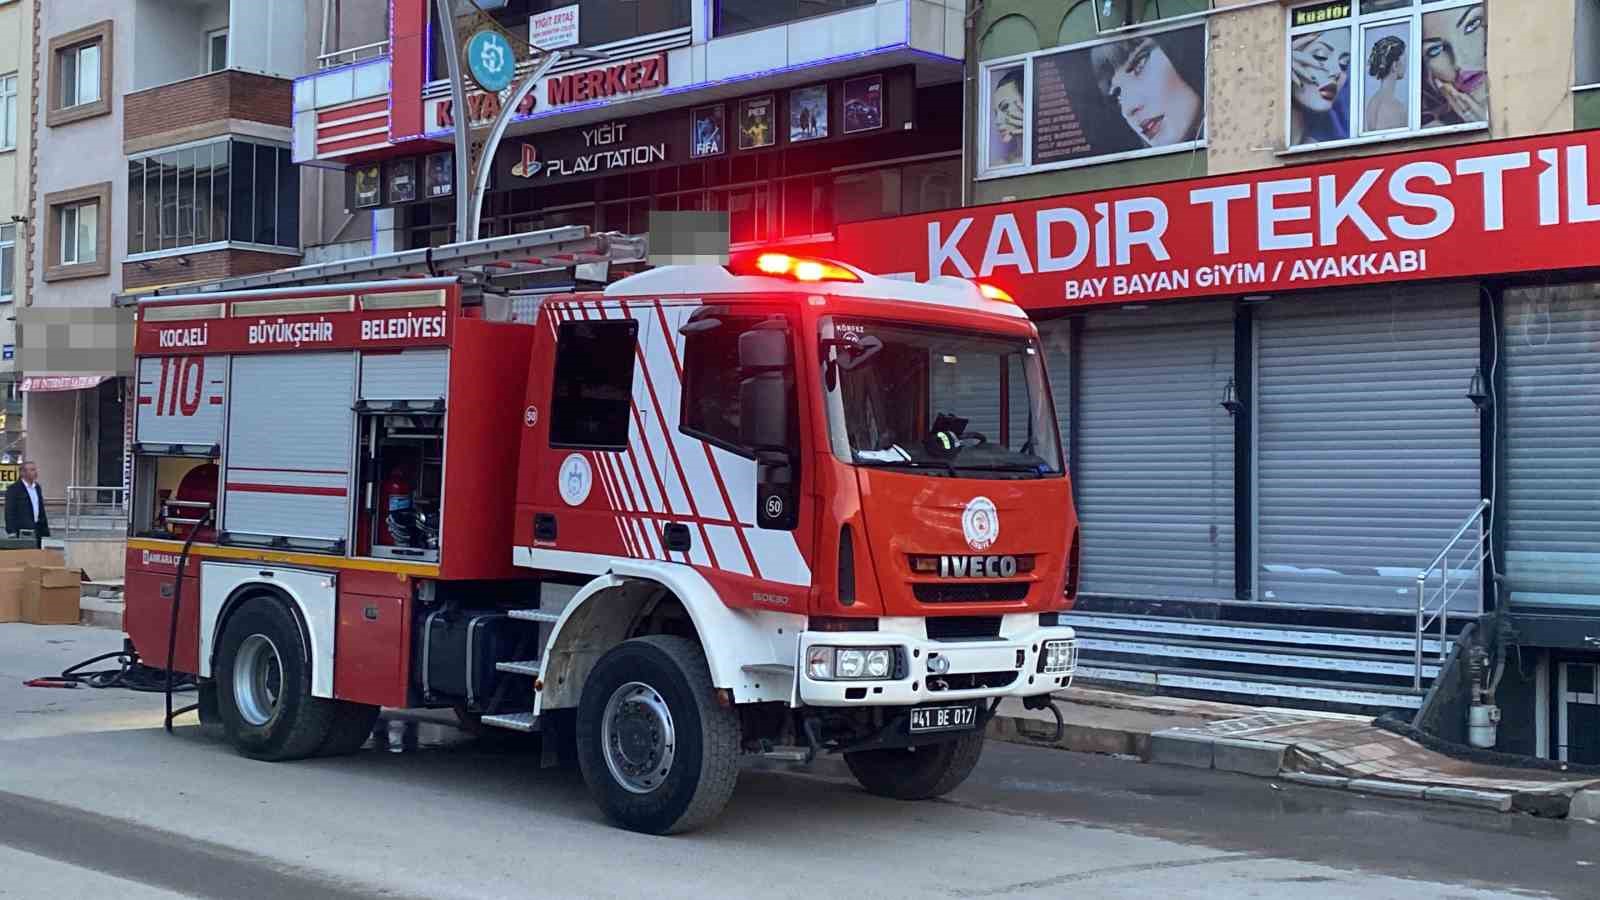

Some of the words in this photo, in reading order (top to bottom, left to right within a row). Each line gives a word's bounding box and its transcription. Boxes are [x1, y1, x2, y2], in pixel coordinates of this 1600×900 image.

[437, 91, 501, 127] KYA
[546, 143, 665, 177] PLAYSTATION
[697, 140, 719, 155] FIFA
[1065, 276, 1108, 300] BAY
[1113, 268, 1189, 296] BAYAN
[1290, 248, 1427, 281] AYAKKABI
[159, 323, 208, 348] KOCAELİ
[249, 317, 333, 347] BÜYÜKŞEHİR
[361, 311, 447, 340] BELEDİYESİ
[156, 353, 204, 416] 110
[769, 500, 781, 512] 50
[941, 555, 1017, 578] IVECO
[919, 711, 930, 727] 41
[937, 709, 949, 726] BE
